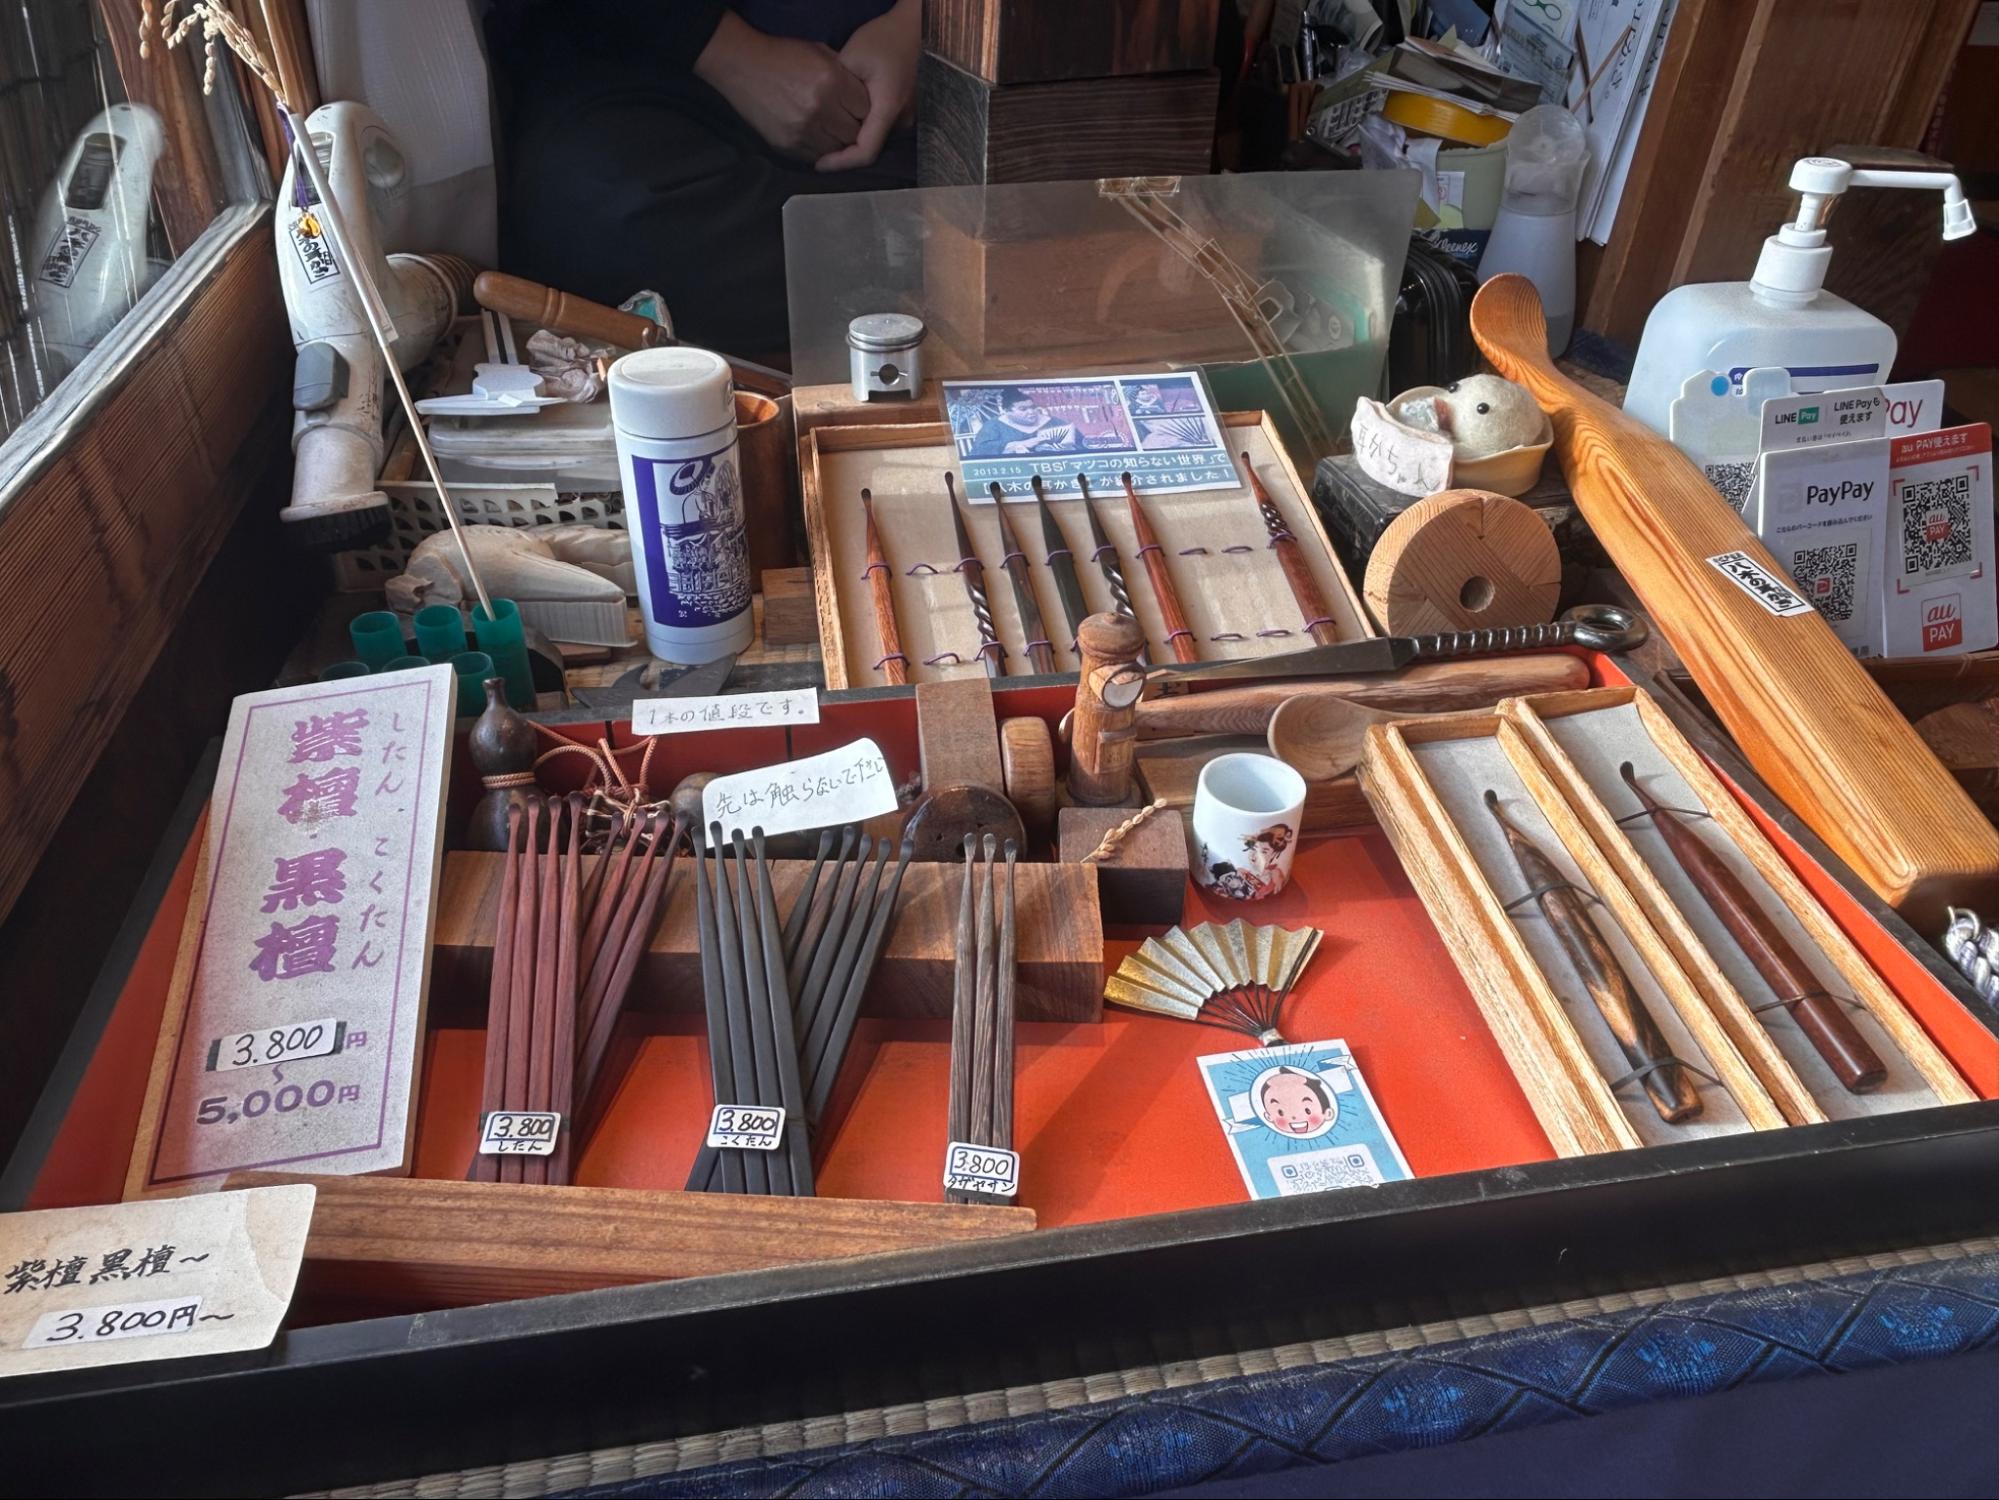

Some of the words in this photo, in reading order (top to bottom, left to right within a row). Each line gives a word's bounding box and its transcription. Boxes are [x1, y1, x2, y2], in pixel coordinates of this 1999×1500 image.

[1834, 400, 1854, 411] LINE
[1855, 399, 1872, 410] Pay
[1775, 412, 1797, 424] LINE
[1800, 409, 1818, 422] Pay
[1840, 411, 1872, 425] 使えます
[1806, 481, 1874, 506] PayPay
[1928, 604, 1956, 622] au
[1930, 623, 1955, 643] PAY
[374, 711, 407, 796] したん
[276, 707, 369, 826] 紫檀
[352, 836, 391, 970] こくたん
[248, 846, 349, 983] 黒檀
[196, 1079, 361, 1125] 5,000円
[498, 1140, 542, 1152] したん
[720, 1134, 772, 1147] こくたん
